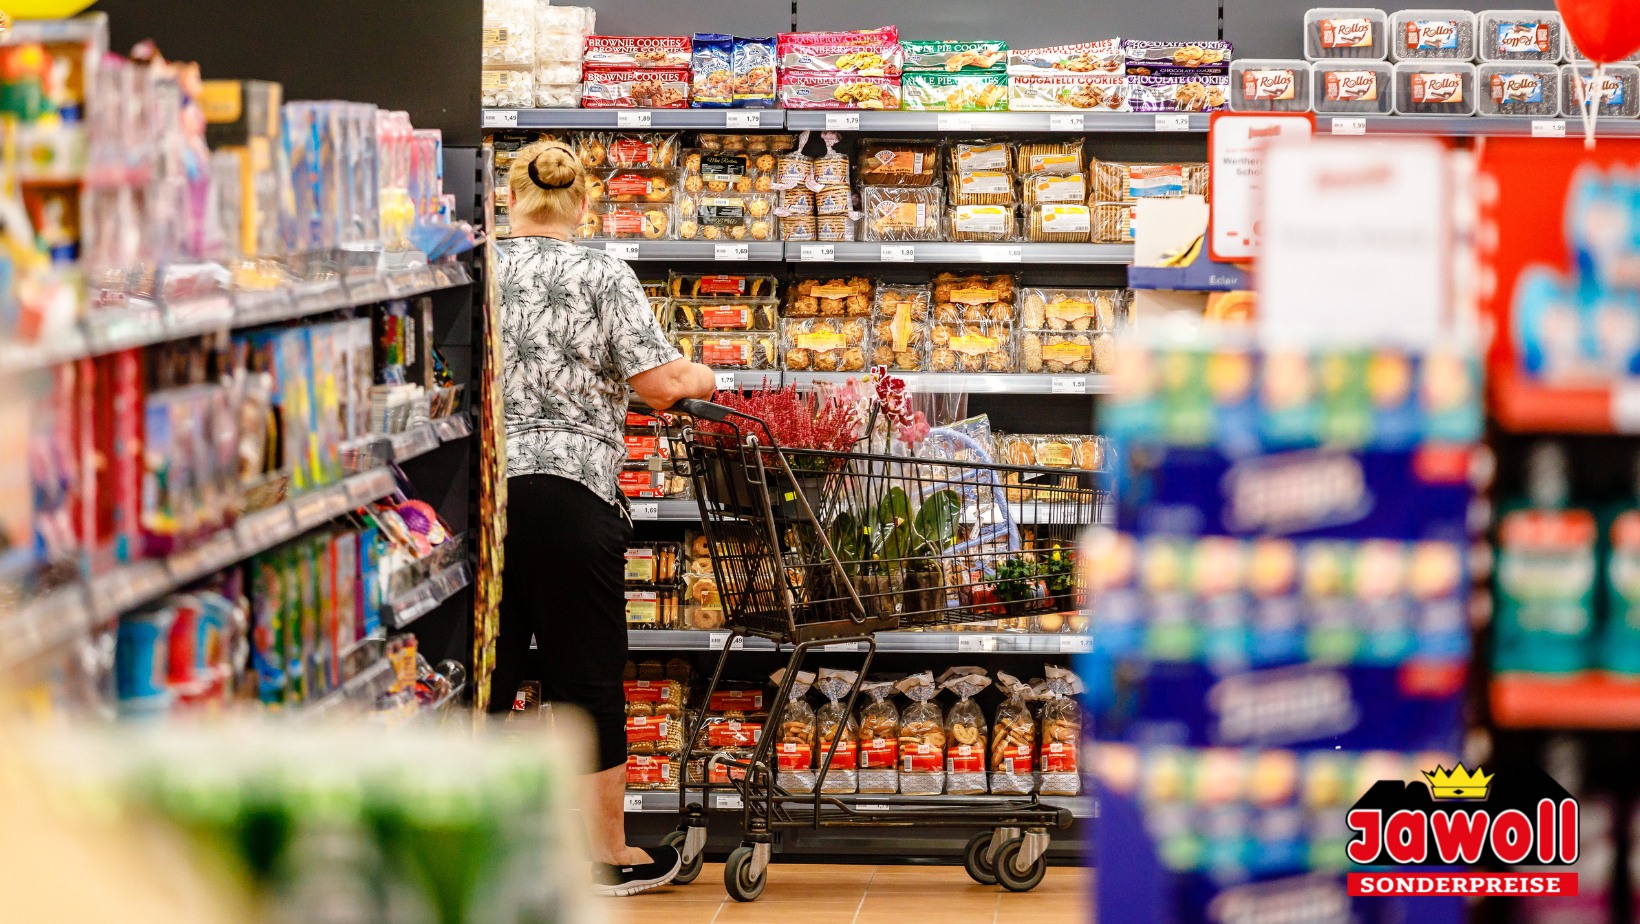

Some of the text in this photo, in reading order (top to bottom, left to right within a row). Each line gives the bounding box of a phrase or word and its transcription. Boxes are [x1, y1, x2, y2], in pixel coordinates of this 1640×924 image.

[1338, 24, 1369, 34] Rollos
[1422, 26, 1454, 37] Rollos
[637, 39, 681, 47] COOKIES
[788, 34, 840, 43] CRANBERRY
[1502, 36, 1532, 46] Rollos
[1068, 39, 1112, 50] COOKIES
[1187, 76, 1229, 84] COOKIES
[1260, 76, 1291, 87] Rollos
[1343, 76, 1373, 87] Rollos
[1428, 78, 1460, 90] Rollos
[1507, 79, 1538, 90] Rollos
[1208, 275, 1238, 285] Eclair
